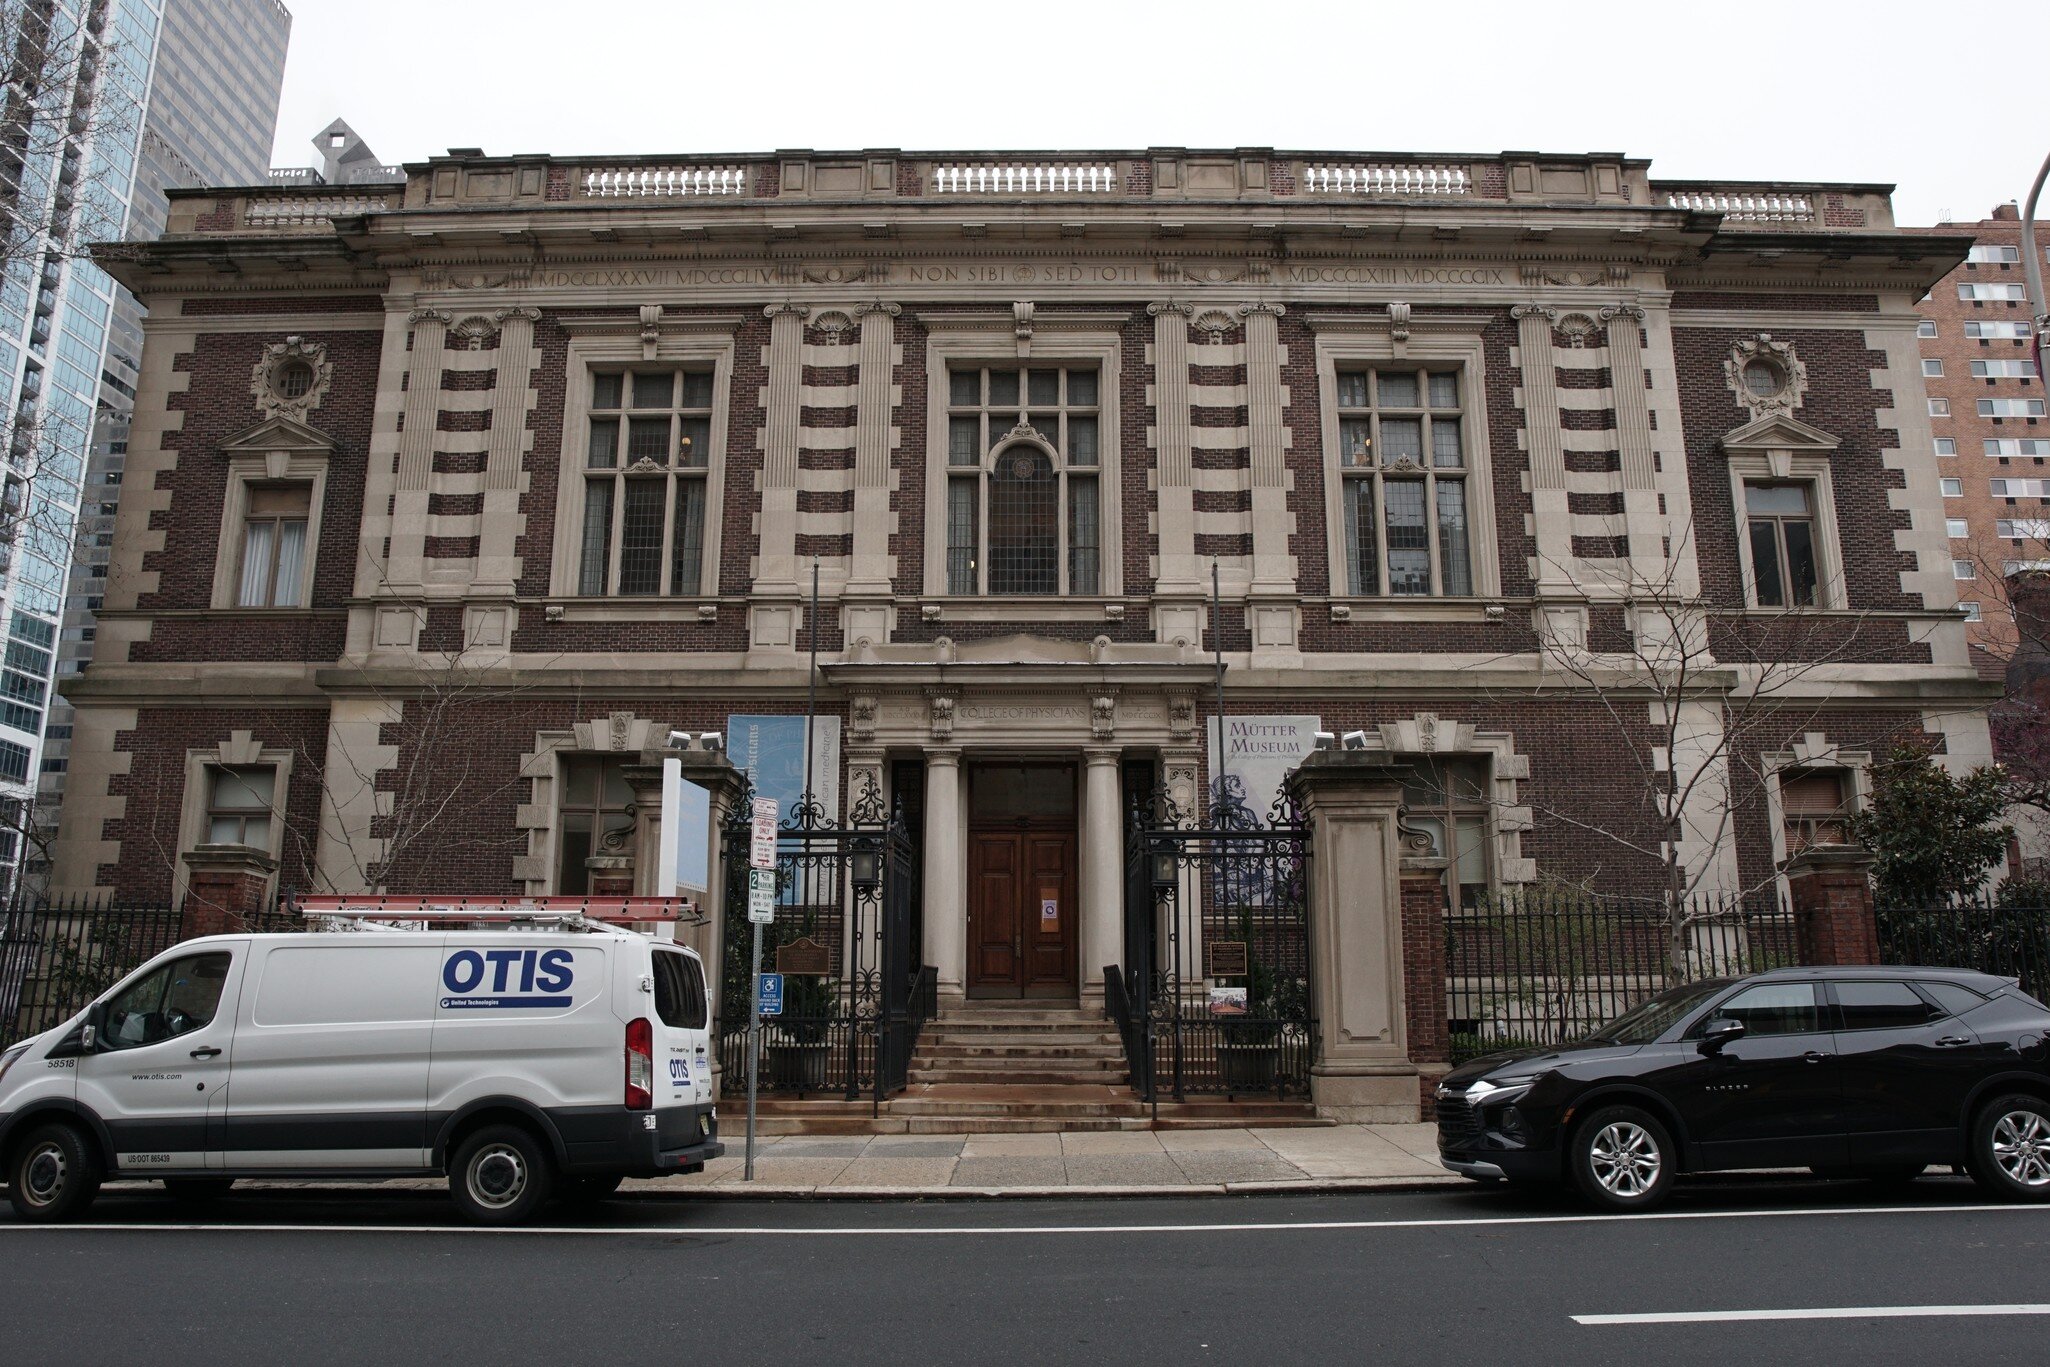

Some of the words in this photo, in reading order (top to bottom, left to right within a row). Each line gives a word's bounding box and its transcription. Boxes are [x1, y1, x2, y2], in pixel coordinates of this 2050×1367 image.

[539, 271, 669, 286] MDCCLXXXVII
[676, 268, 774, 285] MDCCCLIV
[910, 266, 959, 281] NON
[967, 266, 1005, 281] SIBI
[1043, 266, 1082, 281] SED
[1089, 266, 1138, 281] TOTI
[1288, 267, 1397, 284] MDCCCLXIII
[1404, 268, 1504, 284] MDCCCCIX
[960, 707, 1007, 719] COLLEGE
[1008, 707, 1023, 719] OF
[1025, 707, 1085, 719] PHYSICIANS
[1229, 722, 1298, 736] MÜTTER
[1231, 739, 1300, 753] MUSEUM
[756, 819, 774, 828] LOADING
[751, 874, 758, 887] 2
[443, 949, 574, 993] OTIS
[47, 1059, 75, 1068] 58518
[669, 1059, 689, 1079] OTIS
[132, 1072, 182, 1080] www.otis.com
